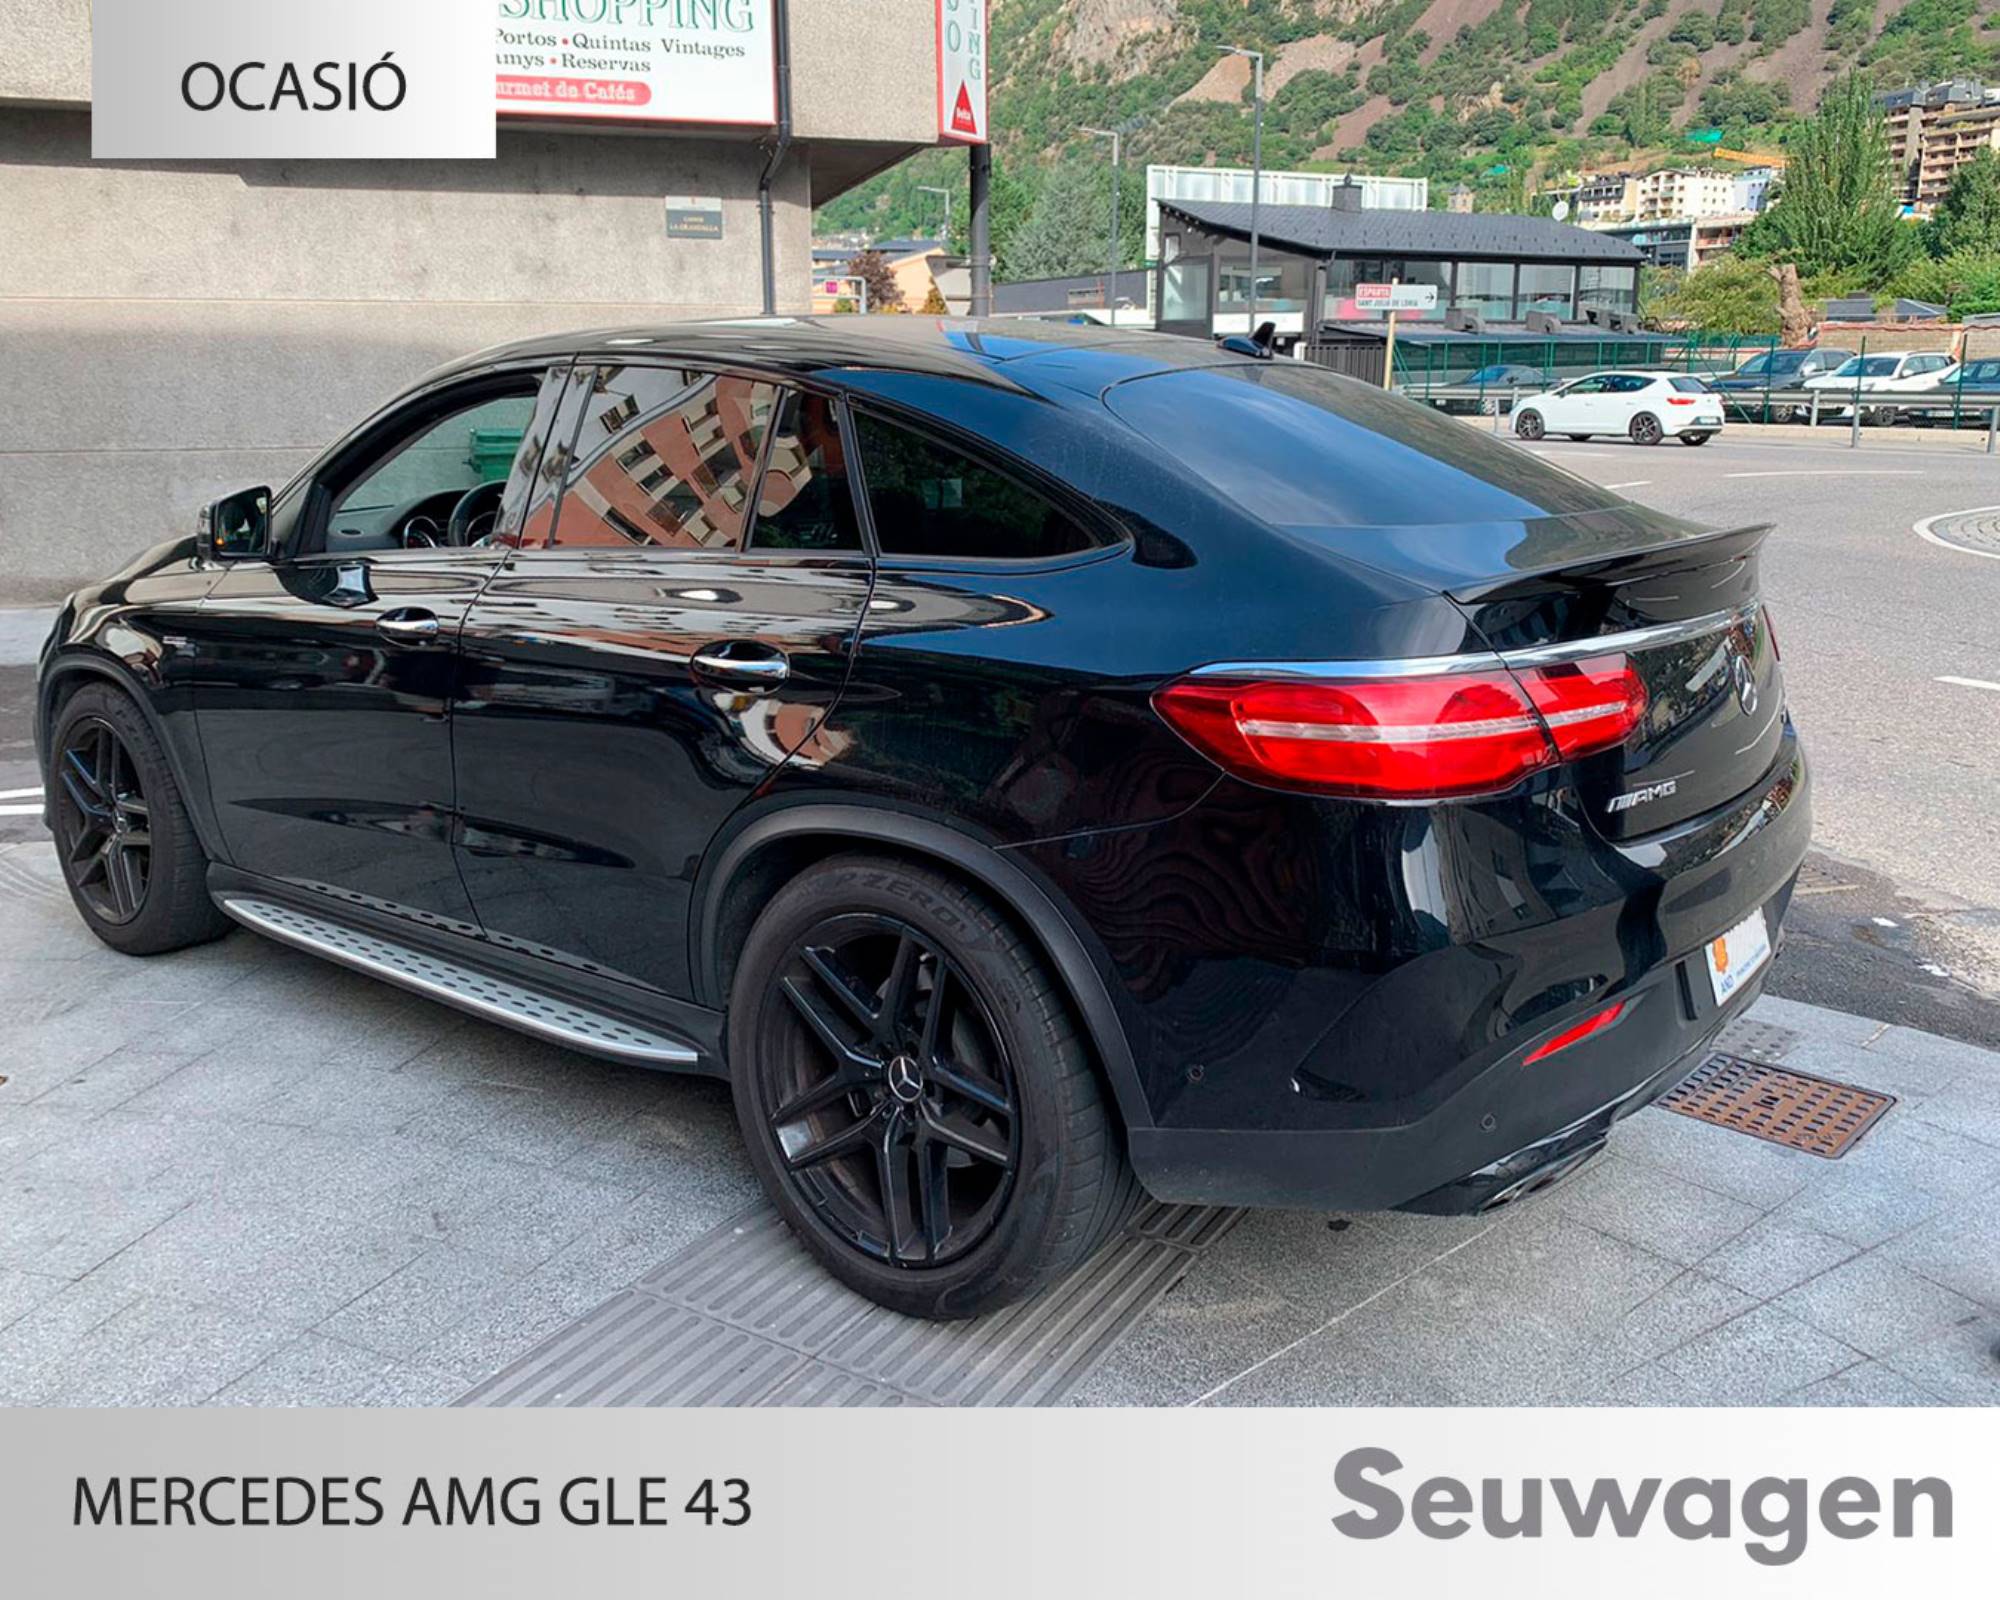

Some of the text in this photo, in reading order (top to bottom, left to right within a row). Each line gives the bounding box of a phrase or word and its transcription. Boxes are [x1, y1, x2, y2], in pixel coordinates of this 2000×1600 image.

[572, 33, 651, 52] Quintas
[661, 38, 746, 59] Vintages
[562, 53, 651, 72] Reservas
